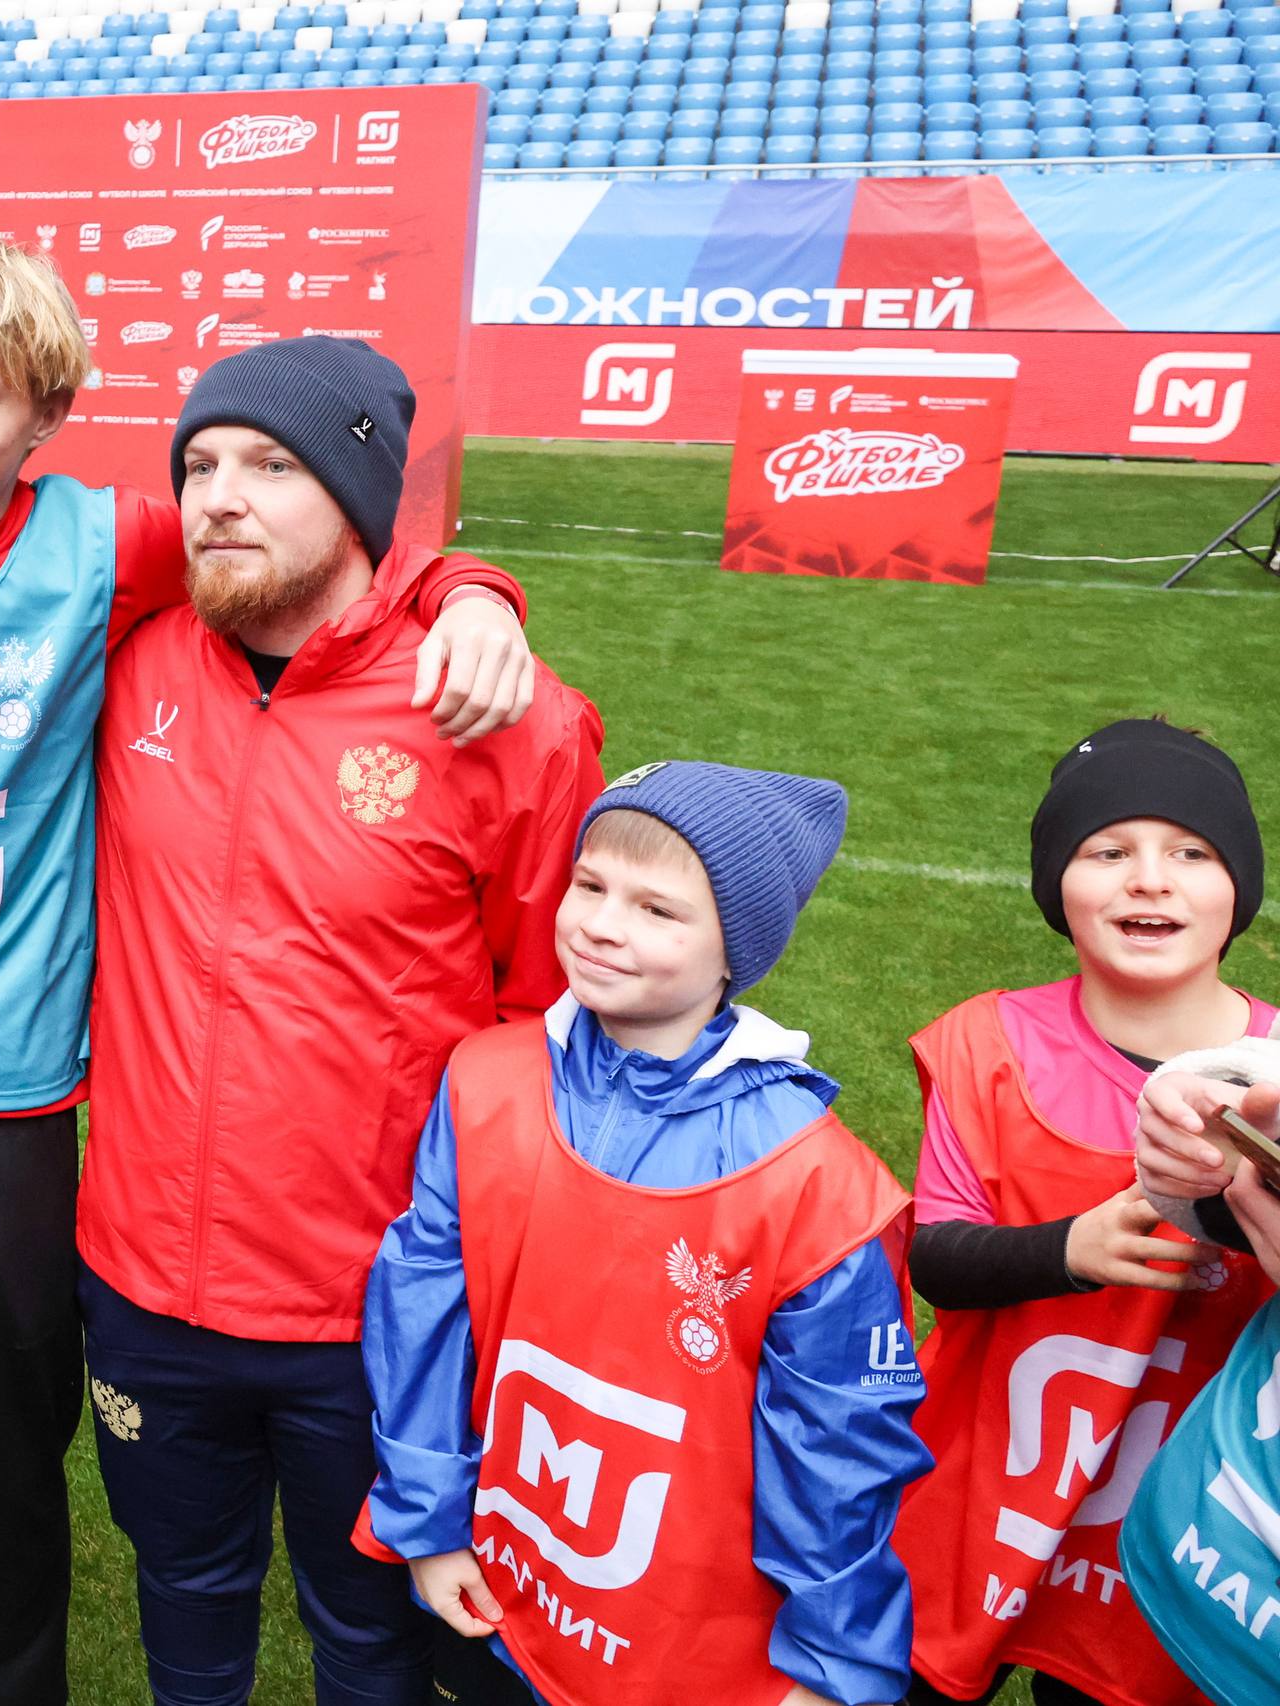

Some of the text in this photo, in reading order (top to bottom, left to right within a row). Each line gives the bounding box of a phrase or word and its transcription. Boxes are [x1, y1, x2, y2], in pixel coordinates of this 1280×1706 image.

[356, 155, 397, 165] МАГНИТ
[128, 736, 176, 763] JÖGEL
[471, 1535, 631, 1666] МАГНИТ
[1171, 1522, 1280, 1662] МАГ
